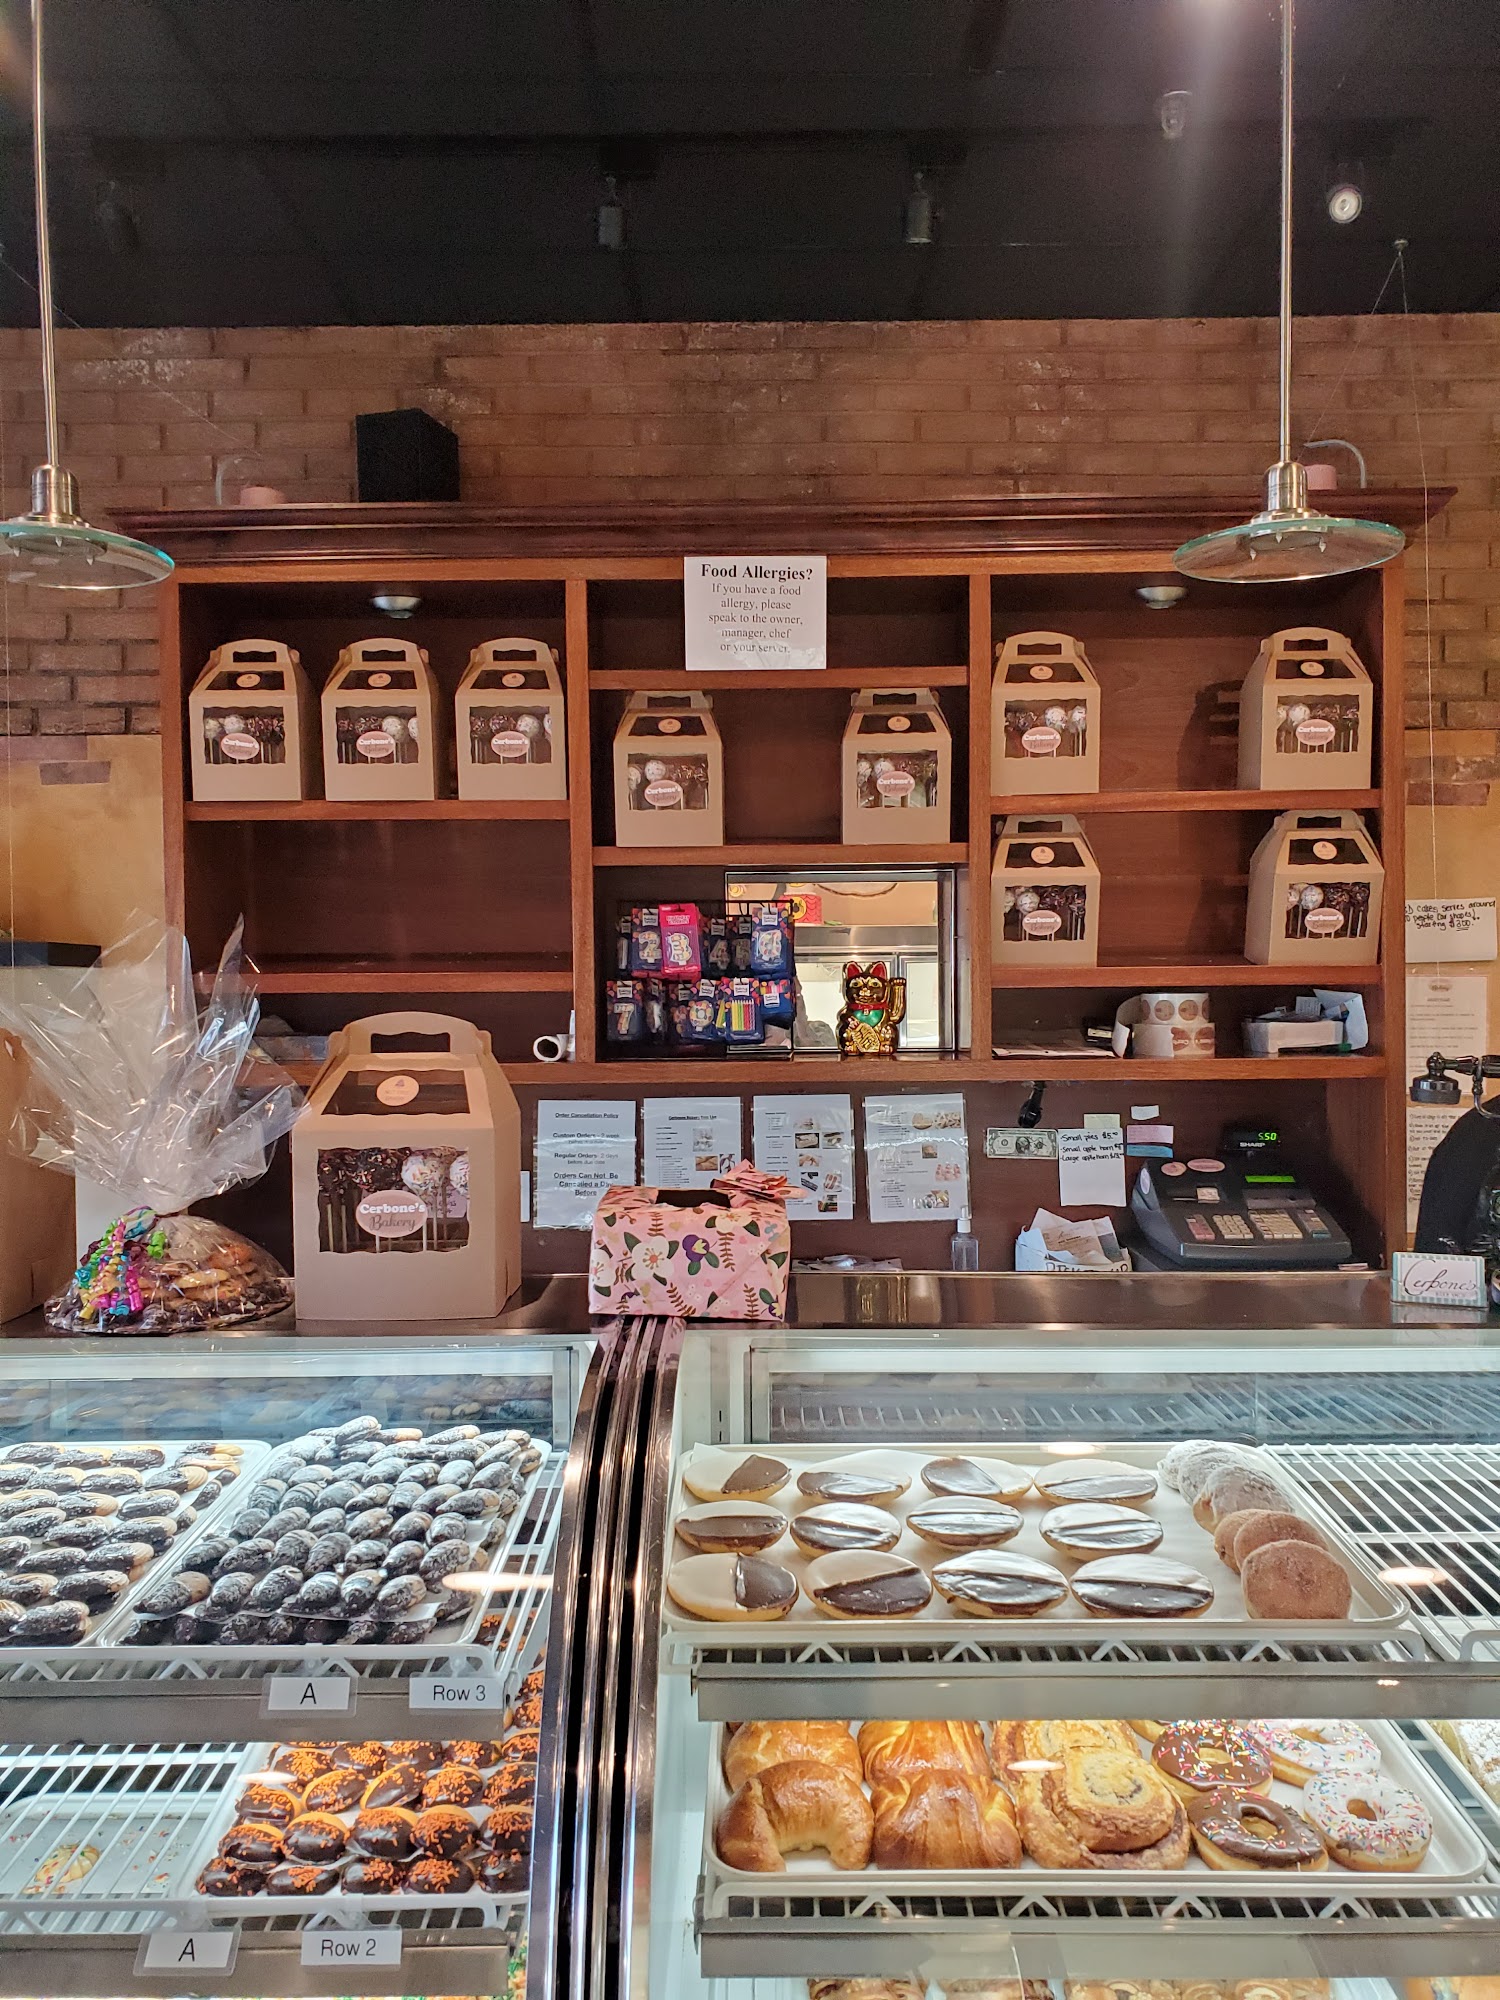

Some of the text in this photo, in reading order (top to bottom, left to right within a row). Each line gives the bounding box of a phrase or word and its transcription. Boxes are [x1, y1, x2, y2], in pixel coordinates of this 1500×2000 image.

[701, 563, 813, 582] Food Allergies?
[712, 583, 721, 593] If
[723, 584, 741, 595] you
[744, 584, 767, 594] have
[779, 585, 801, 596] food
[720, 598, 791, 611] allergy, please
[708, 612, 803, 625] speak to the owner,
[721, 629, 792, 640] manager, chef
[720, 643, 790, 654] or your server.
[554, 1172, 577, 1180] Orders
[574, 1189, 597, 1197] Before
[360, 1202, 426, 1214] Cerbone's
[370, 1214, 416, 1231] Bakery
[299, 1682, 317, 1705] A
[433, 1684, 486, 1701] Row 3
[178, 1938, 195, 1962] A
[321, 1938, 377, 1957] Row 2
